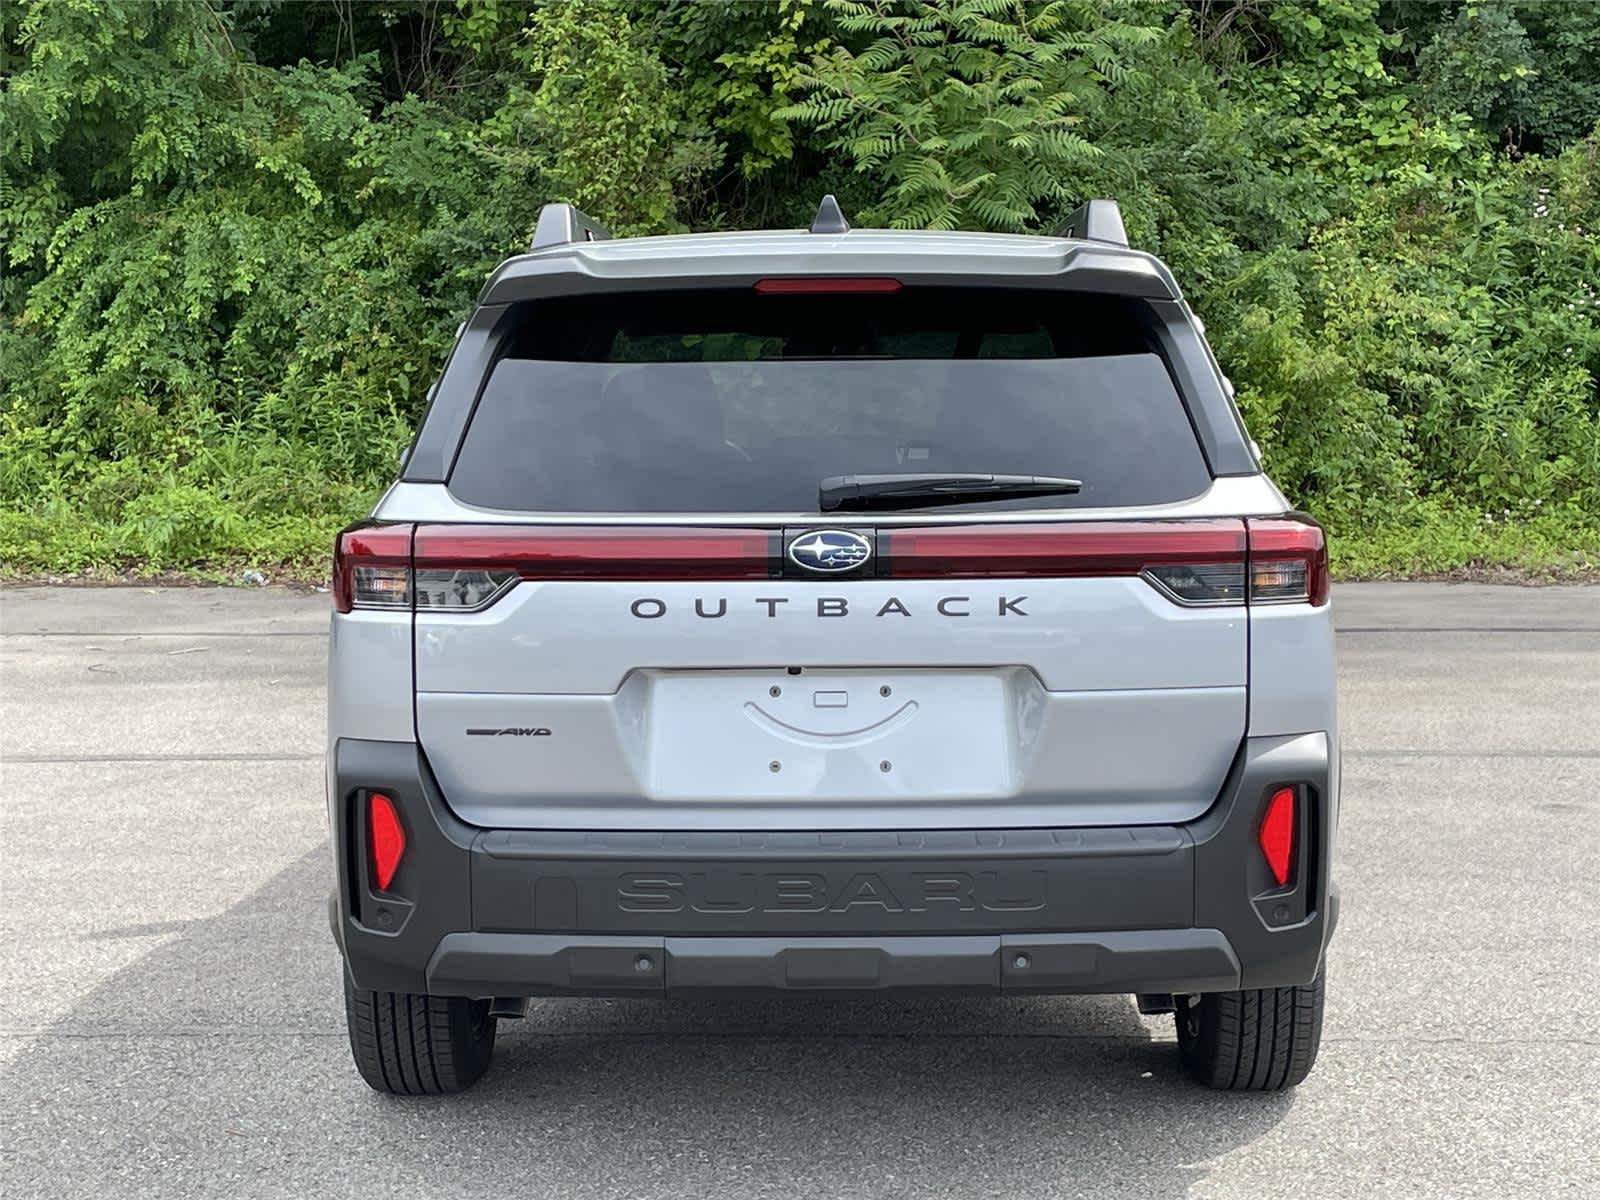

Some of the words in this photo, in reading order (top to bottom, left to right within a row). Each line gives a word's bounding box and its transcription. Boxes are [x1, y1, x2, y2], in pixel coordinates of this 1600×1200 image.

[630, 596, 1029, 618] OUTBACK
[498, 727, 552, 737] AWD
[617, 870, 1048, 913] SUBARU
